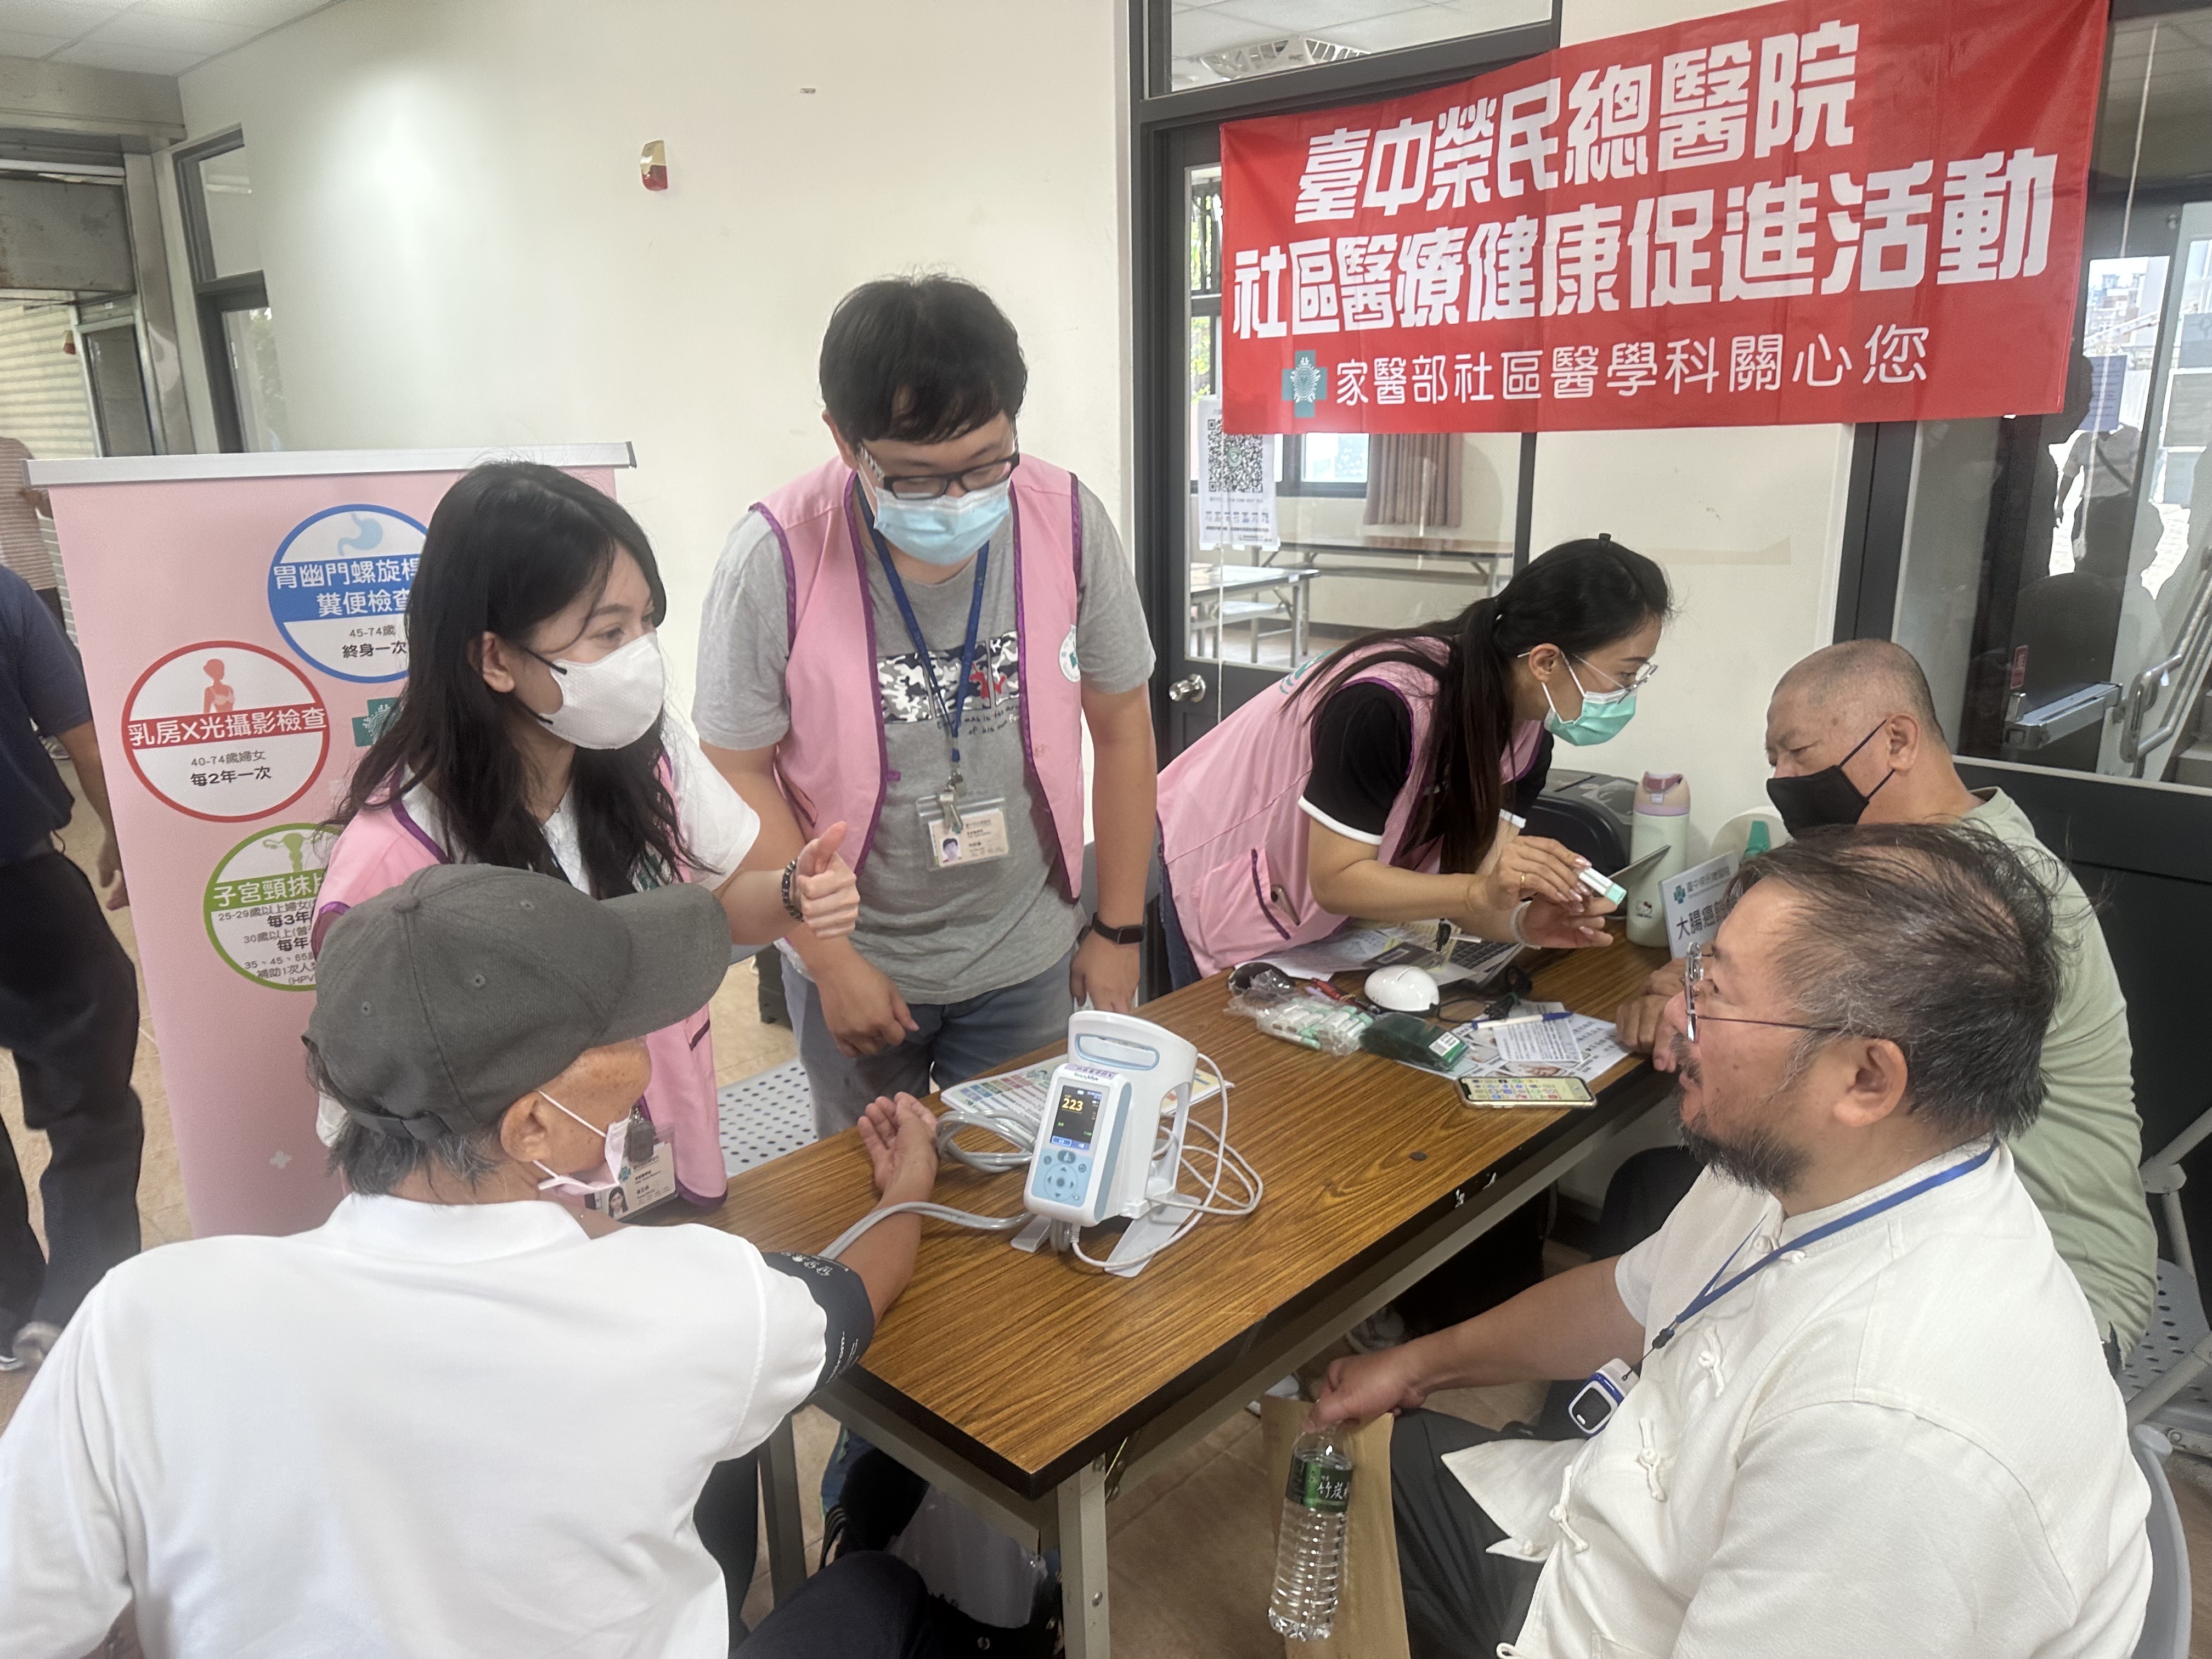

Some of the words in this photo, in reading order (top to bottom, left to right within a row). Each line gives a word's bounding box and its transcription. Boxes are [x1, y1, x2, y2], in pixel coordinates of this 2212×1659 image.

[1295, 20, 1863, 225] 臺中榮民總醫院
[1233, 148, 2058, 340] 社區醫療健康促進活動
[1335, 323, 1929, 408] 家醫部社區醫學科關心您
[316, 587, 411, 617] 糞便檢查
[349, 624, 396, 637] 45-74歲
[342, 640, 408, 658] 終身一次
[127, 707, 327, 746] 乳房X光攝影檢查
[190, 750, 267, 767] 40-74歲婦女
[190, 766, 273, 787] 每2年一次
[218, 899, 316, 922] 25-29歲以上婦女(
[1061, 1097, 1084, 1112] 223
